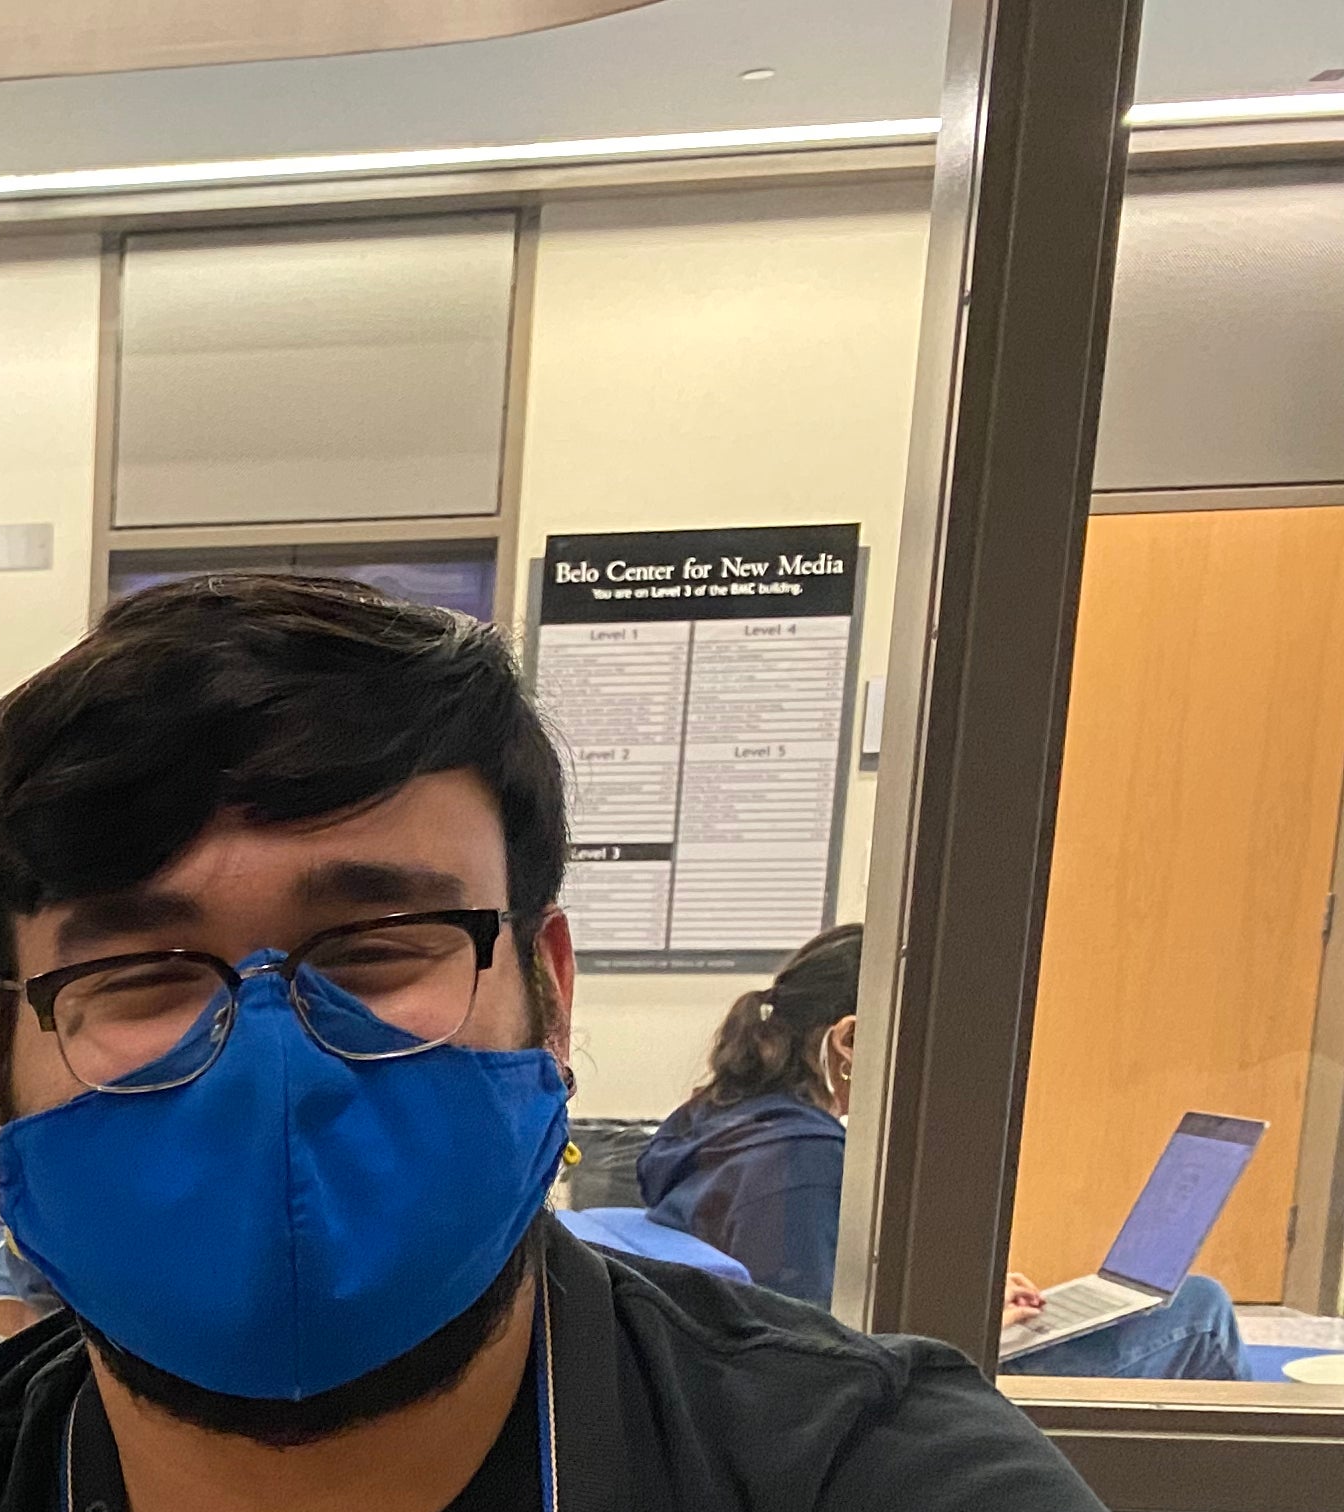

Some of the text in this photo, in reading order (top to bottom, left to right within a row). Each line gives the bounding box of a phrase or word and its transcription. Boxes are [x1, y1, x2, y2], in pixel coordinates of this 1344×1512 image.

[555, 552, 844, 583] Belo Center for New Media
[592, 588, 612, 600] You
[614, 589, 633, 599] are
[634, 589, 649, 598] on
[650, 586, 681, 598] Level
[684, 585, 692, 597] 3
[694, 584, 708, 596] of
[709, 584, 728, 596] the
[590, 629, 638, 641] Level 1
[744, 624, 797, 637] Level 4
[579, 749, 630, 762] Level 2
[734, 746, 787, 759] Level 5
[571, 846, 621, 861] Level 3
